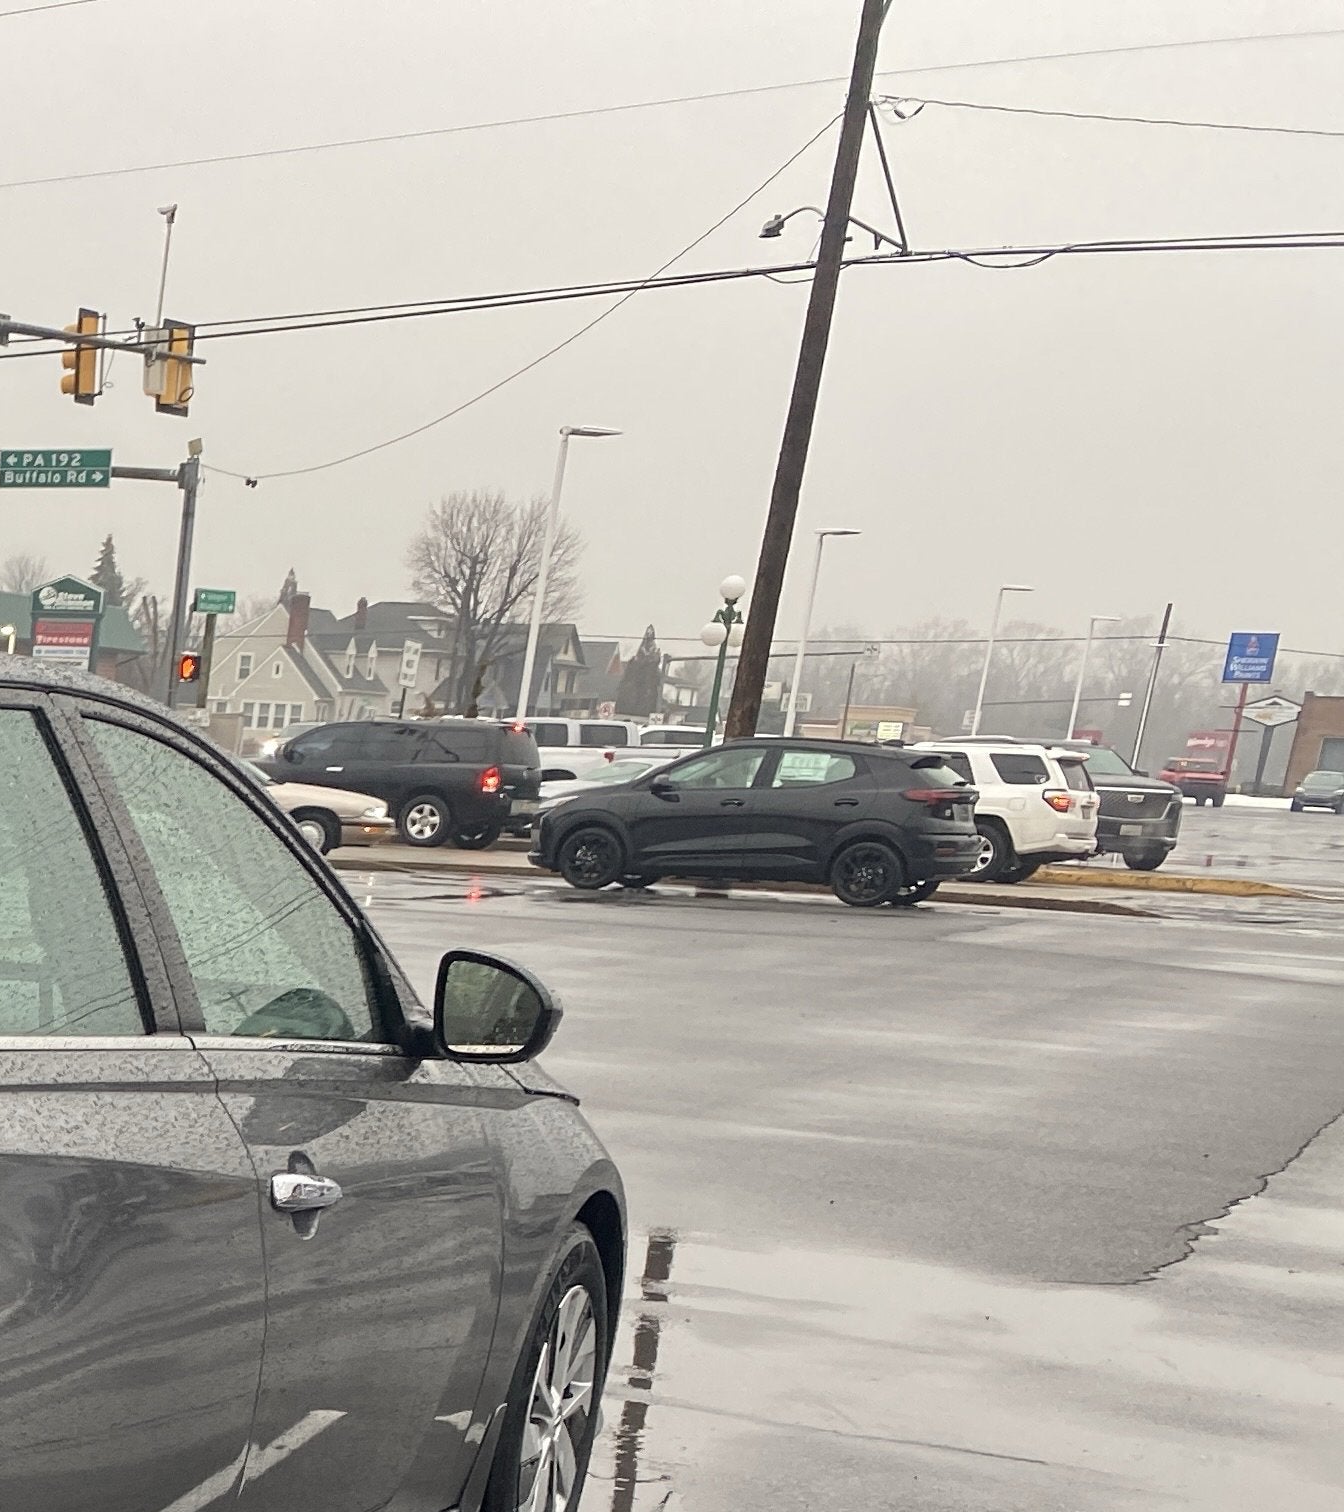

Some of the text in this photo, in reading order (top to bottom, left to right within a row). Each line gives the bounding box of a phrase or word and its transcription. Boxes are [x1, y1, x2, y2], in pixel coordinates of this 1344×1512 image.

[22, 452, 81, 467] PA 192
[4, 470, 87, 483] Buffalo Rd
